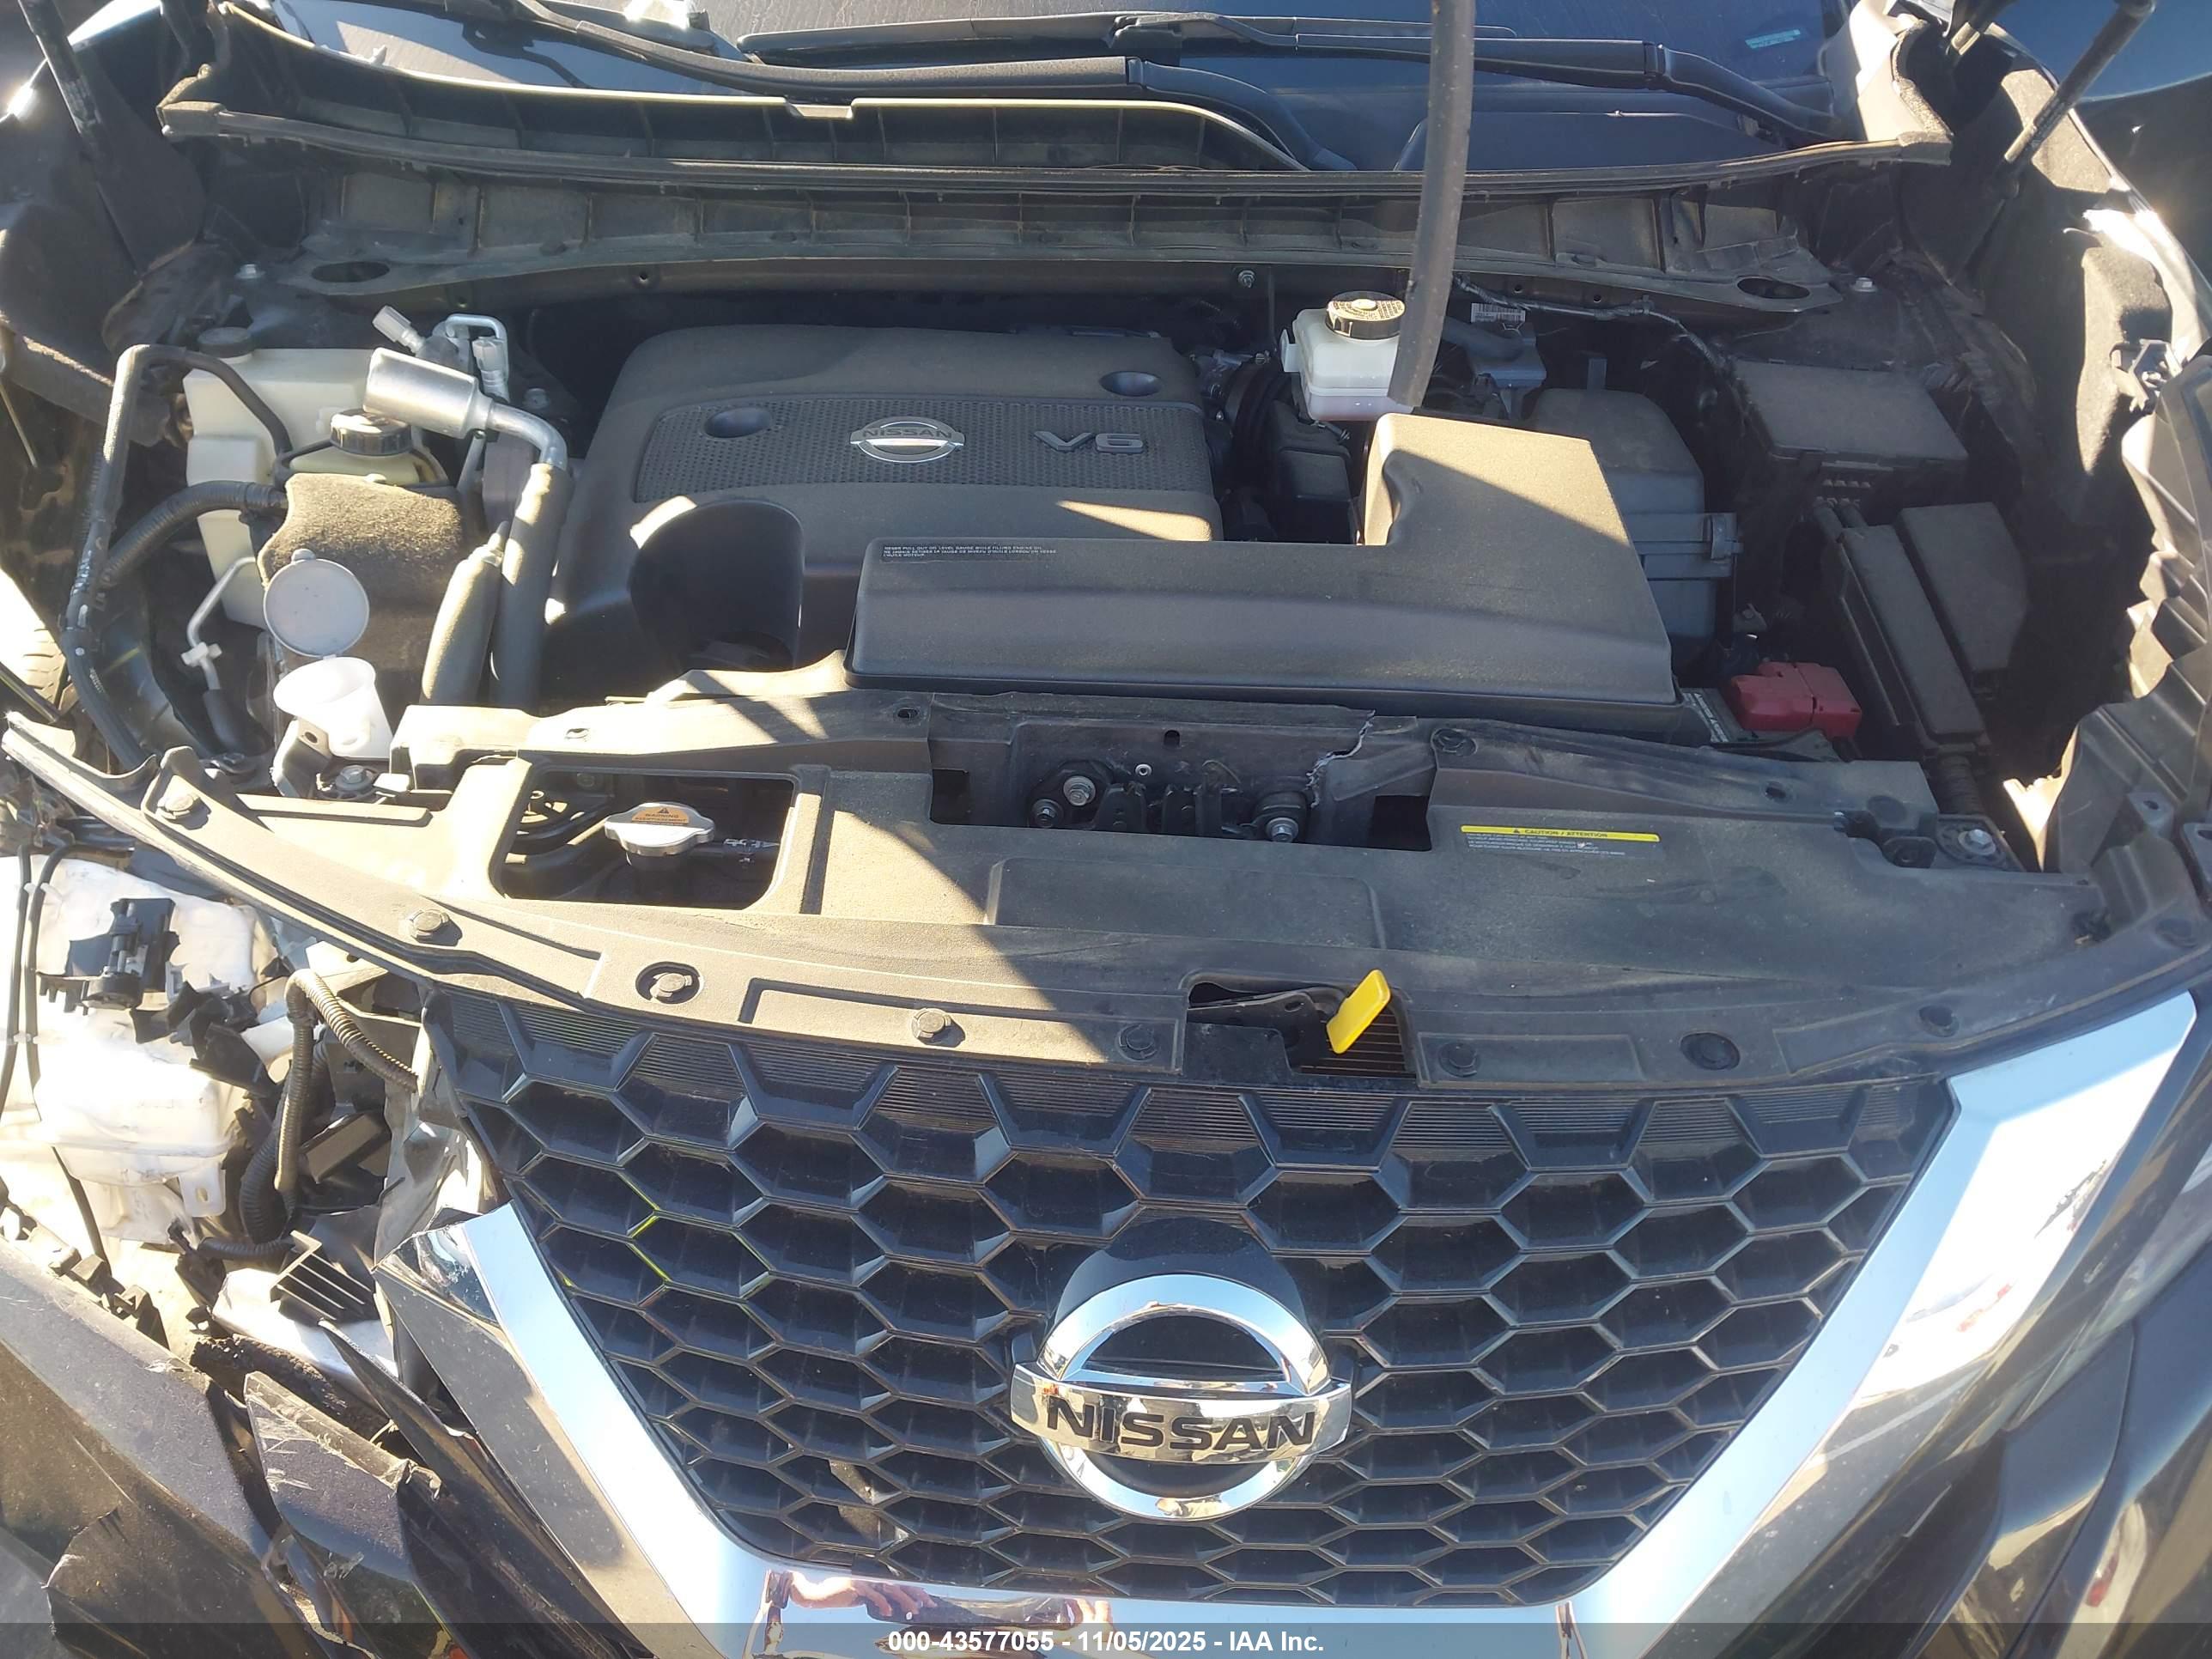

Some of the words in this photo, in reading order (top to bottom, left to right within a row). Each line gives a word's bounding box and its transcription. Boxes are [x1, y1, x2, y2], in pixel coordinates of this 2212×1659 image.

[862, 428, 952, 439] NISSAN
[1034, 430, 1144, 453] V6
[1047, 1396, 1316, 1451] NISSAN
